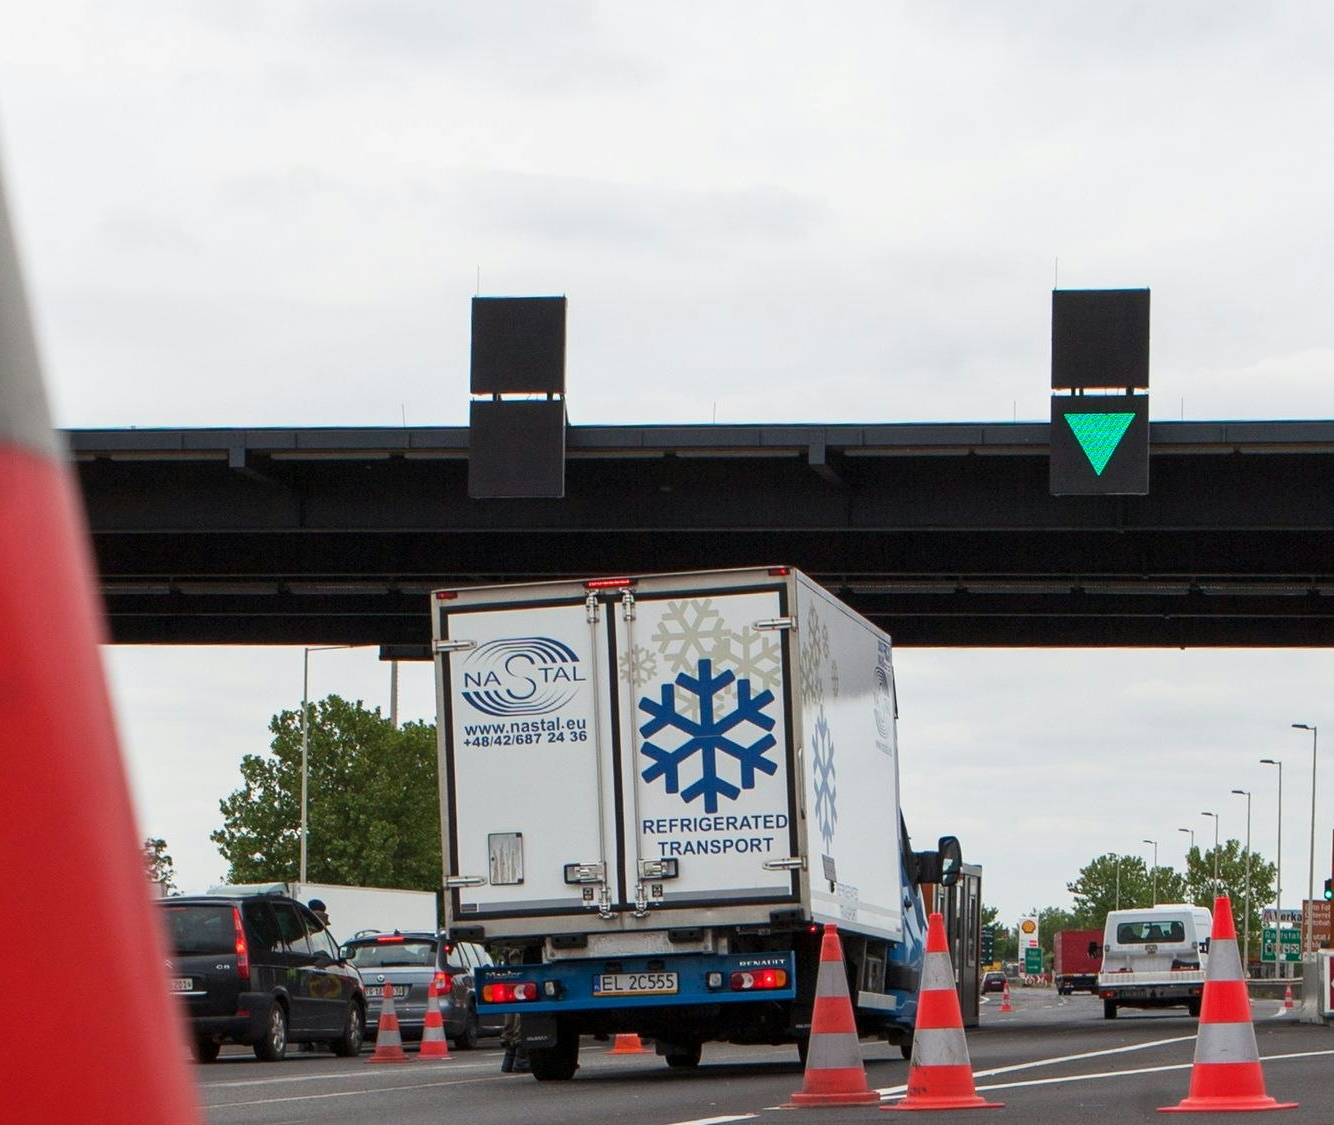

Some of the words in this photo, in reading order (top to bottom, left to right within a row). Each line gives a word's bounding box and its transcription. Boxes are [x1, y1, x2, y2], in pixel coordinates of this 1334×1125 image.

[464, 717, 586, 736] www.nastal.eu
[463, 733, 542, 747] +48/42/687
[548, 732, 565, 743] 24
[570, 731, 587, 742] 36
[642, 814, 788, 834] REFRIGERATED
[658, 837, 774, 856] TRANSPORT
[739, 958, 786, 967] RENAULT
[602, 976, 623, 991] EL
[629, 974, 674, 990] 2C555
